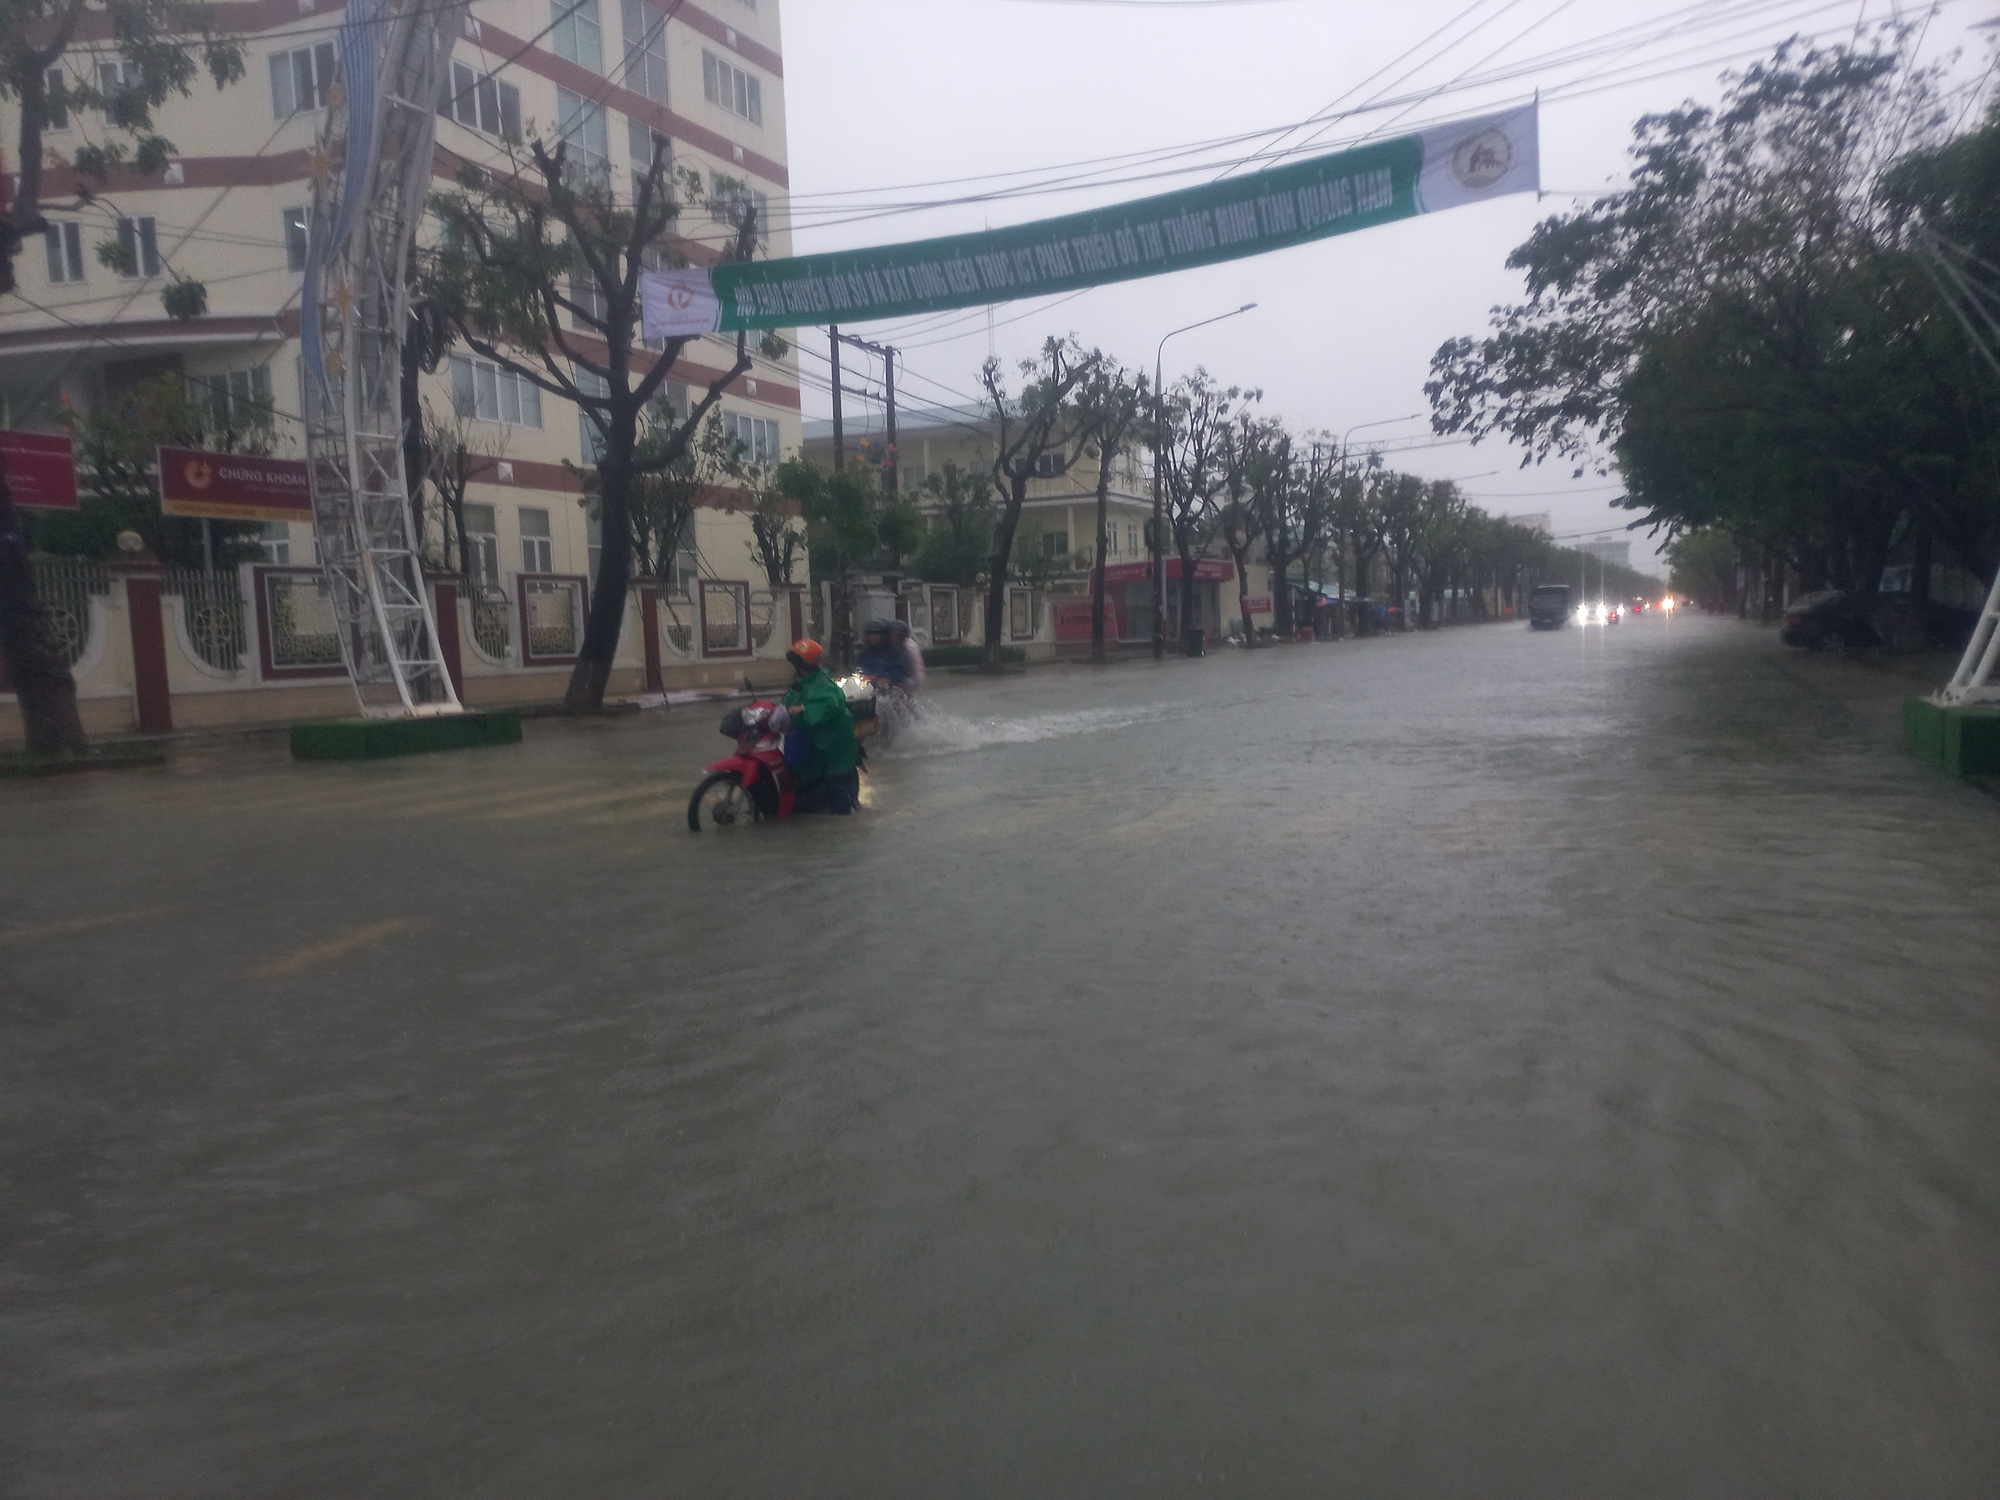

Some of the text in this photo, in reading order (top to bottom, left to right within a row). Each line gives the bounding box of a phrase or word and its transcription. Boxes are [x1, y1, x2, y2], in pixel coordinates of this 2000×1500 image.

[752, 271, 786, 315] THẢO
[782, 263, 830, 313] CHUYỂN
[865, 263, 888, 305] VÀ
[883, 261, 912, 303] XÂY
[975, 245, 1015, 289] TRÚC
[1012, 247, 1037, 284] ICT
[1035, 234, 1074, 280] PHÁT
[1071, 218, 1118, 273] TRIỂN
[1114, 219, 1139, 265] ĐÔ
[1137, 221, 1165, 266] THỊ
[1163, 206, 1216, 256] THÔNG
[1214, 199, 1259, 245] MINH
[1257, 182, 1297, 236] TỈNH
[1297, 169, 1353, 231] QUẢNG
[1354, 166, 1393, 214] NAM
[266, 471, 306, 486] KHOÁN
